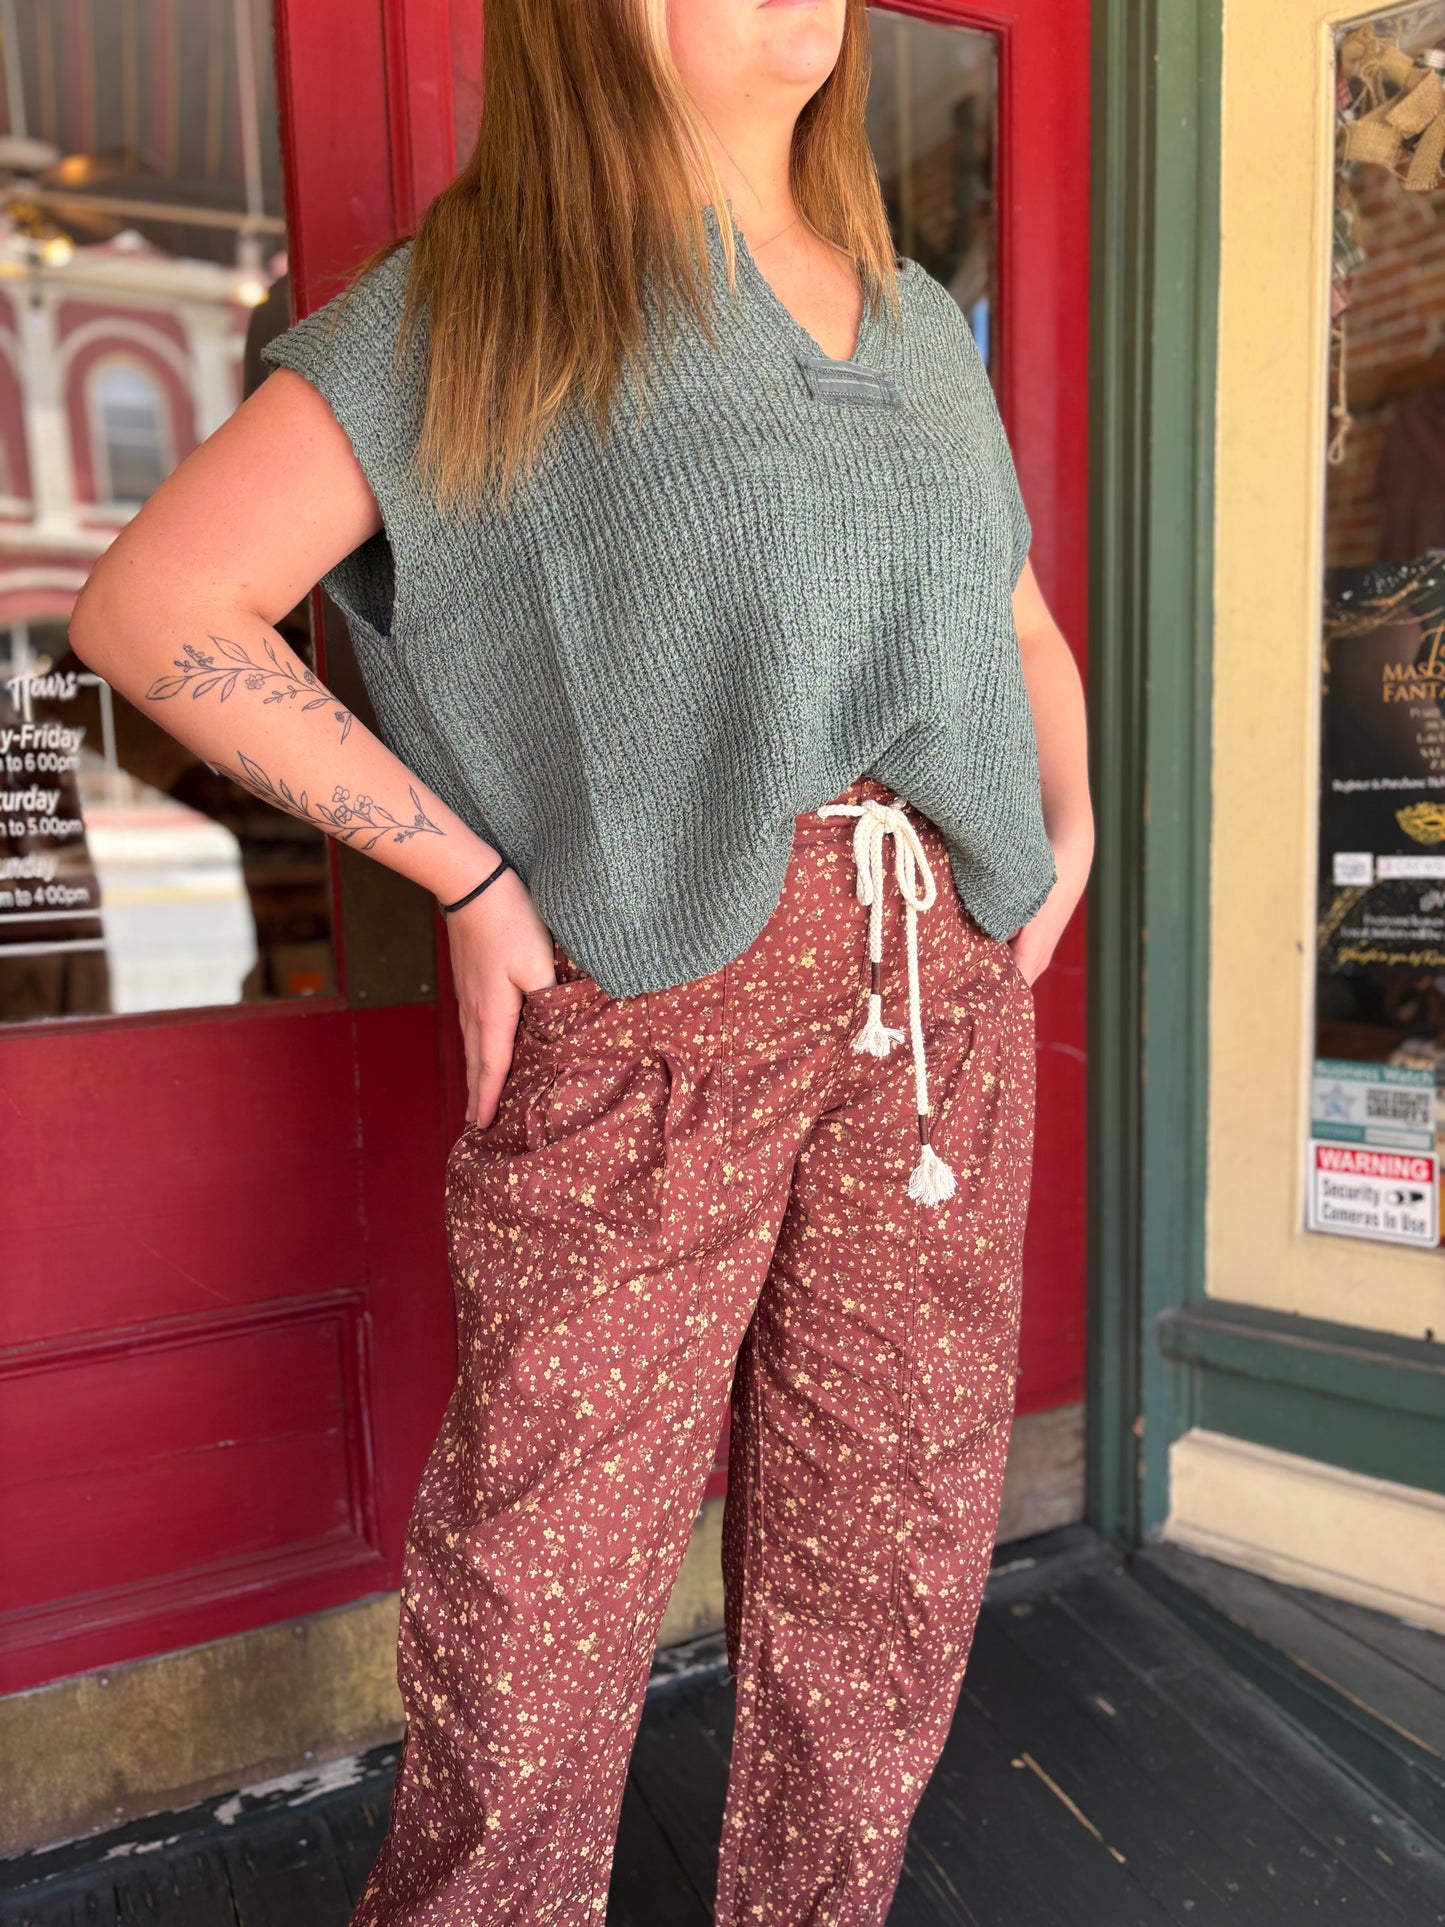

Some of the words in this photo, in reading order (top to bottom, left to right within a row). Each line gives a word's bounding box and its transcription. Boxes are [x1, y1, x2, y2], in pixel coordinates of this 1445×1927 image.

[6, 671, 78, 722] Hours
[6, 754, 23, 772] to
[8, 819, 25, 837] to
[15, 886, 32, 907] to
[1315, 1060, 1379, 1080] Business
[1382, 1067, 1435, 1086] Watch
[1318, 1148, 1429, 1181] WARNING
[1323, 1178, 1380, 1207] Security
[1323, 1202, 1378, 1227] Cameras
[1401, 1212, 1425, 1232] Use
